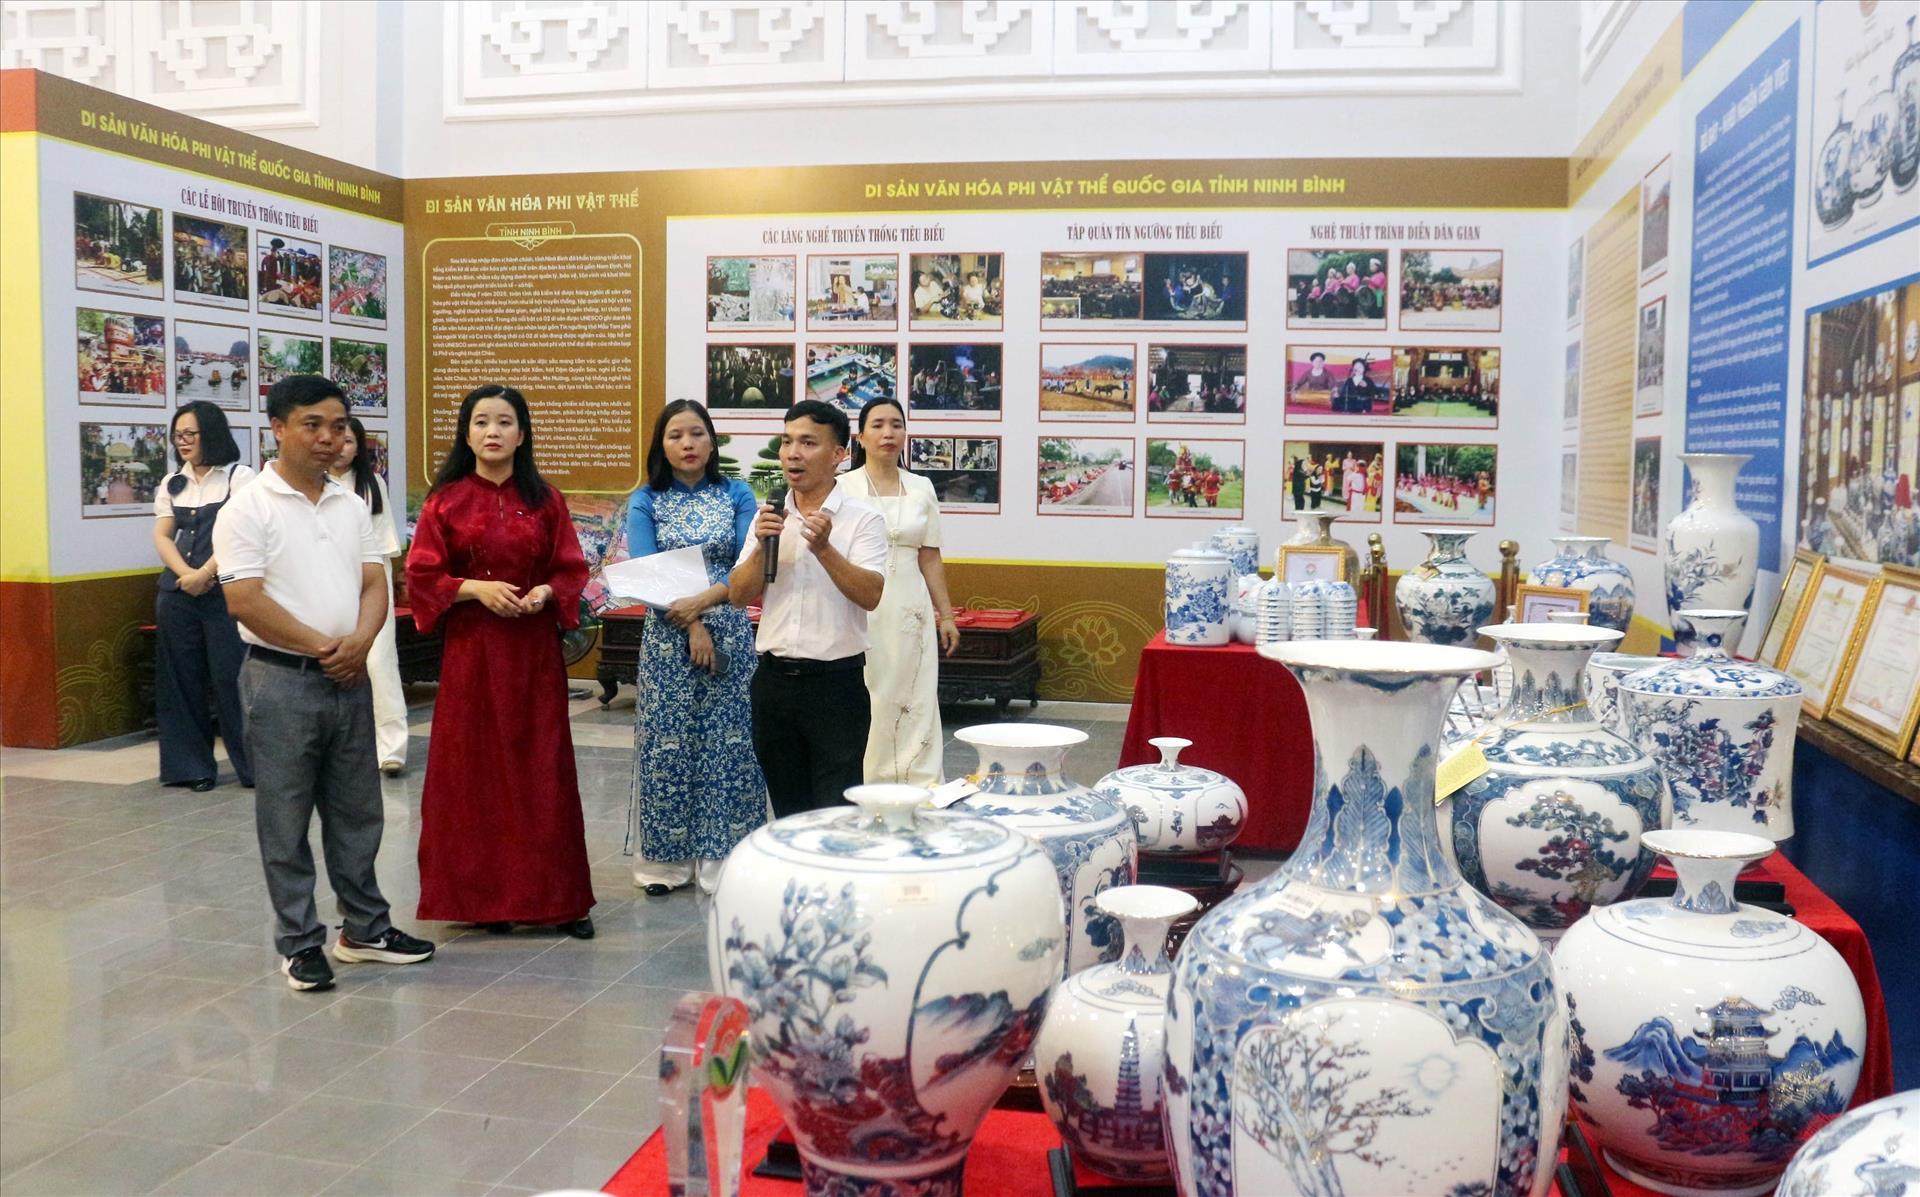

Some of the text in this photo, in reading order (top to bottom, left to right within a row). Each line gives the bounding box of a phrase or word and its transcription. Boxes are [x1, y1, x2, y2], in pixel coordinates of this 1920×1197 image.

[81, 110, 380, 204] DI SẢN VĂN HÓA PHI VẬT THỂ QUỐC GIA TỈNH NINH BÌNH
[865, 174, 1344, 198] DI SẢN VĂN HÓA PHI VẬT THỂ QUỐC GIA TỈNH NINH BÌNH
[425, 187, 638, 213] DI SẢN VĂN HÓA PHI VẬT THỂ
[762, 222, 944, 244] CÁC LÀNG NGHỀ TRUYỀN THỐNG TIÊU BIỂU
